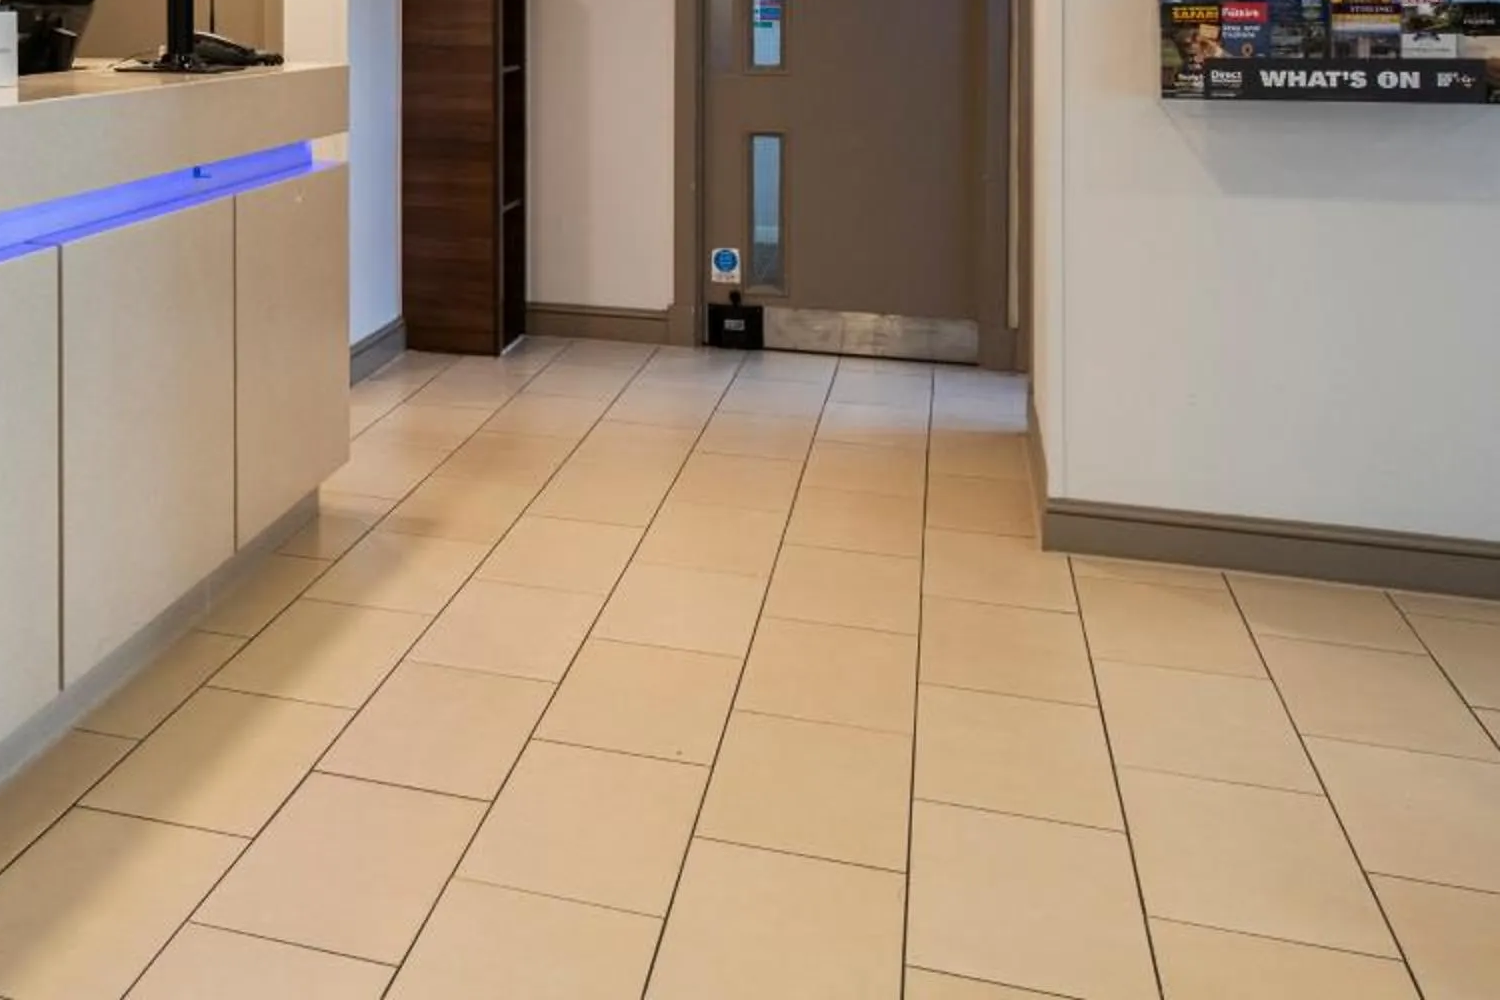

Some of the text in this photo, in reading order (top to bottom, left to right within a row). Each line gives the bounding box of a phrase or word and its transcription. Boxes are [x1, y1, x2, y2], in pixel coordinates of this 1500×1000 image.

[1211, 69, 1242, 79] Direct
[1260, 70, 1367, 89] WHAT'S
[1377, 69, 1421, 89] ON
